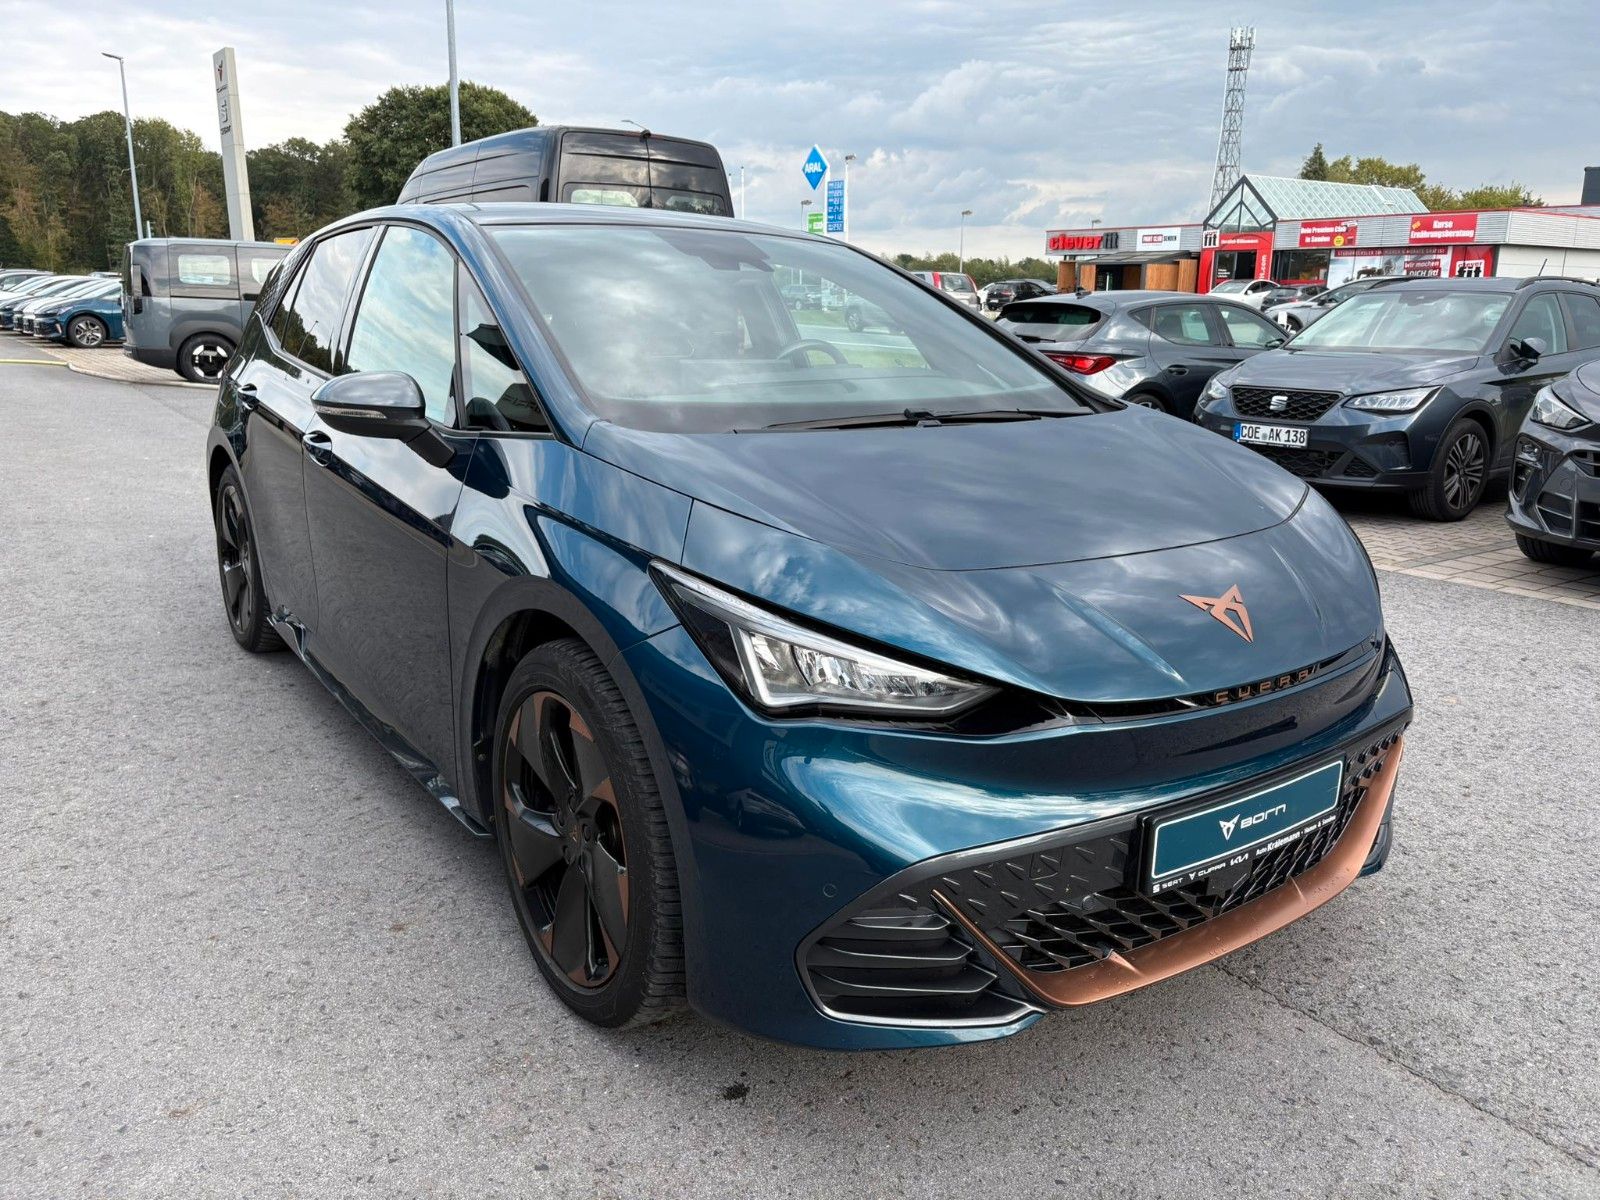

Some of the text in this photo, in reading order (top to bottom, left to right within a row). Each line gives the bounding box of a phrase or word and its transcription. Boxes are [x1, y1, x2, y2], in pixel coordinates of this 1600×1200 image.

[805, 162, 822, 174] ARAL
[1311, 226, 1334, 234] Premium
[1433, 220, 1453, 229] Kurse
[1410, 229, 1475, 239] Ernährungsberatung
[1049, 233, 1103, 251] clever
[1241, 425, 1306, 444] COE AK 138
[1215, 669, 1309, 703] CUPRA
[1162, 877, 1183, 889] SEAT
[1197, 862, 1226, 877] CUPRA
